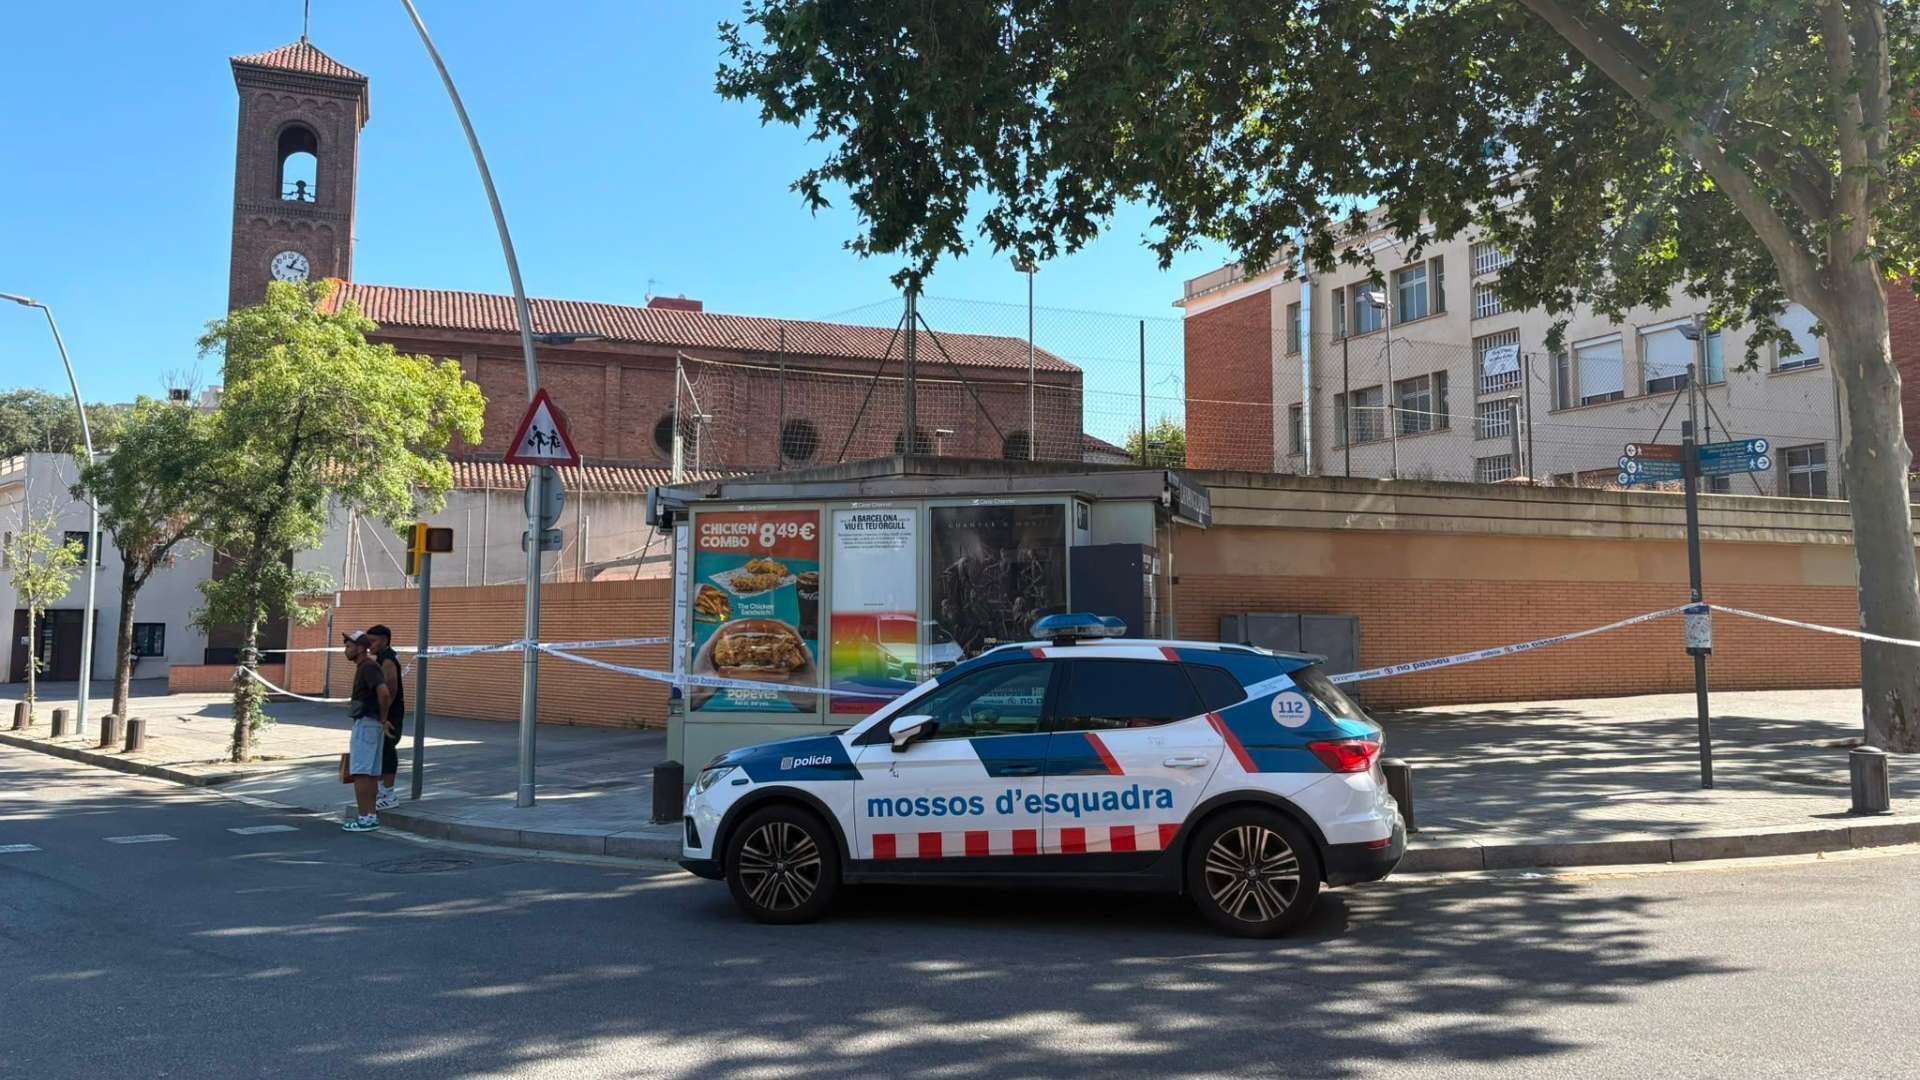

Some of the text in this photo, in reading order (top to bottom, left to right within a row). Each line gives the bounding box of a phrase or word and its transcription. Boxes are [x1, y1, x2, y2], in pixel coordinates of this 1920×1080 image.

[852, 514, 857, 522] A
[857, 514, 898, 522] BARCELONA
[701, 523, 757, 535] CHICKEN
[844, 521, 906, 530] VIU EL TEU ORGULL
[700, 536, 750, 548] COMBO
[750, 603, 774, 611] Chicken
[1397, 663, 1410, 672] no
[1412, 657, 1450, 671] passeu
[1279, 701, 1304, 713] 112
[793, 755, 832, 769] policia
[867, 784, 1174, 818] mossos d'esquadra
